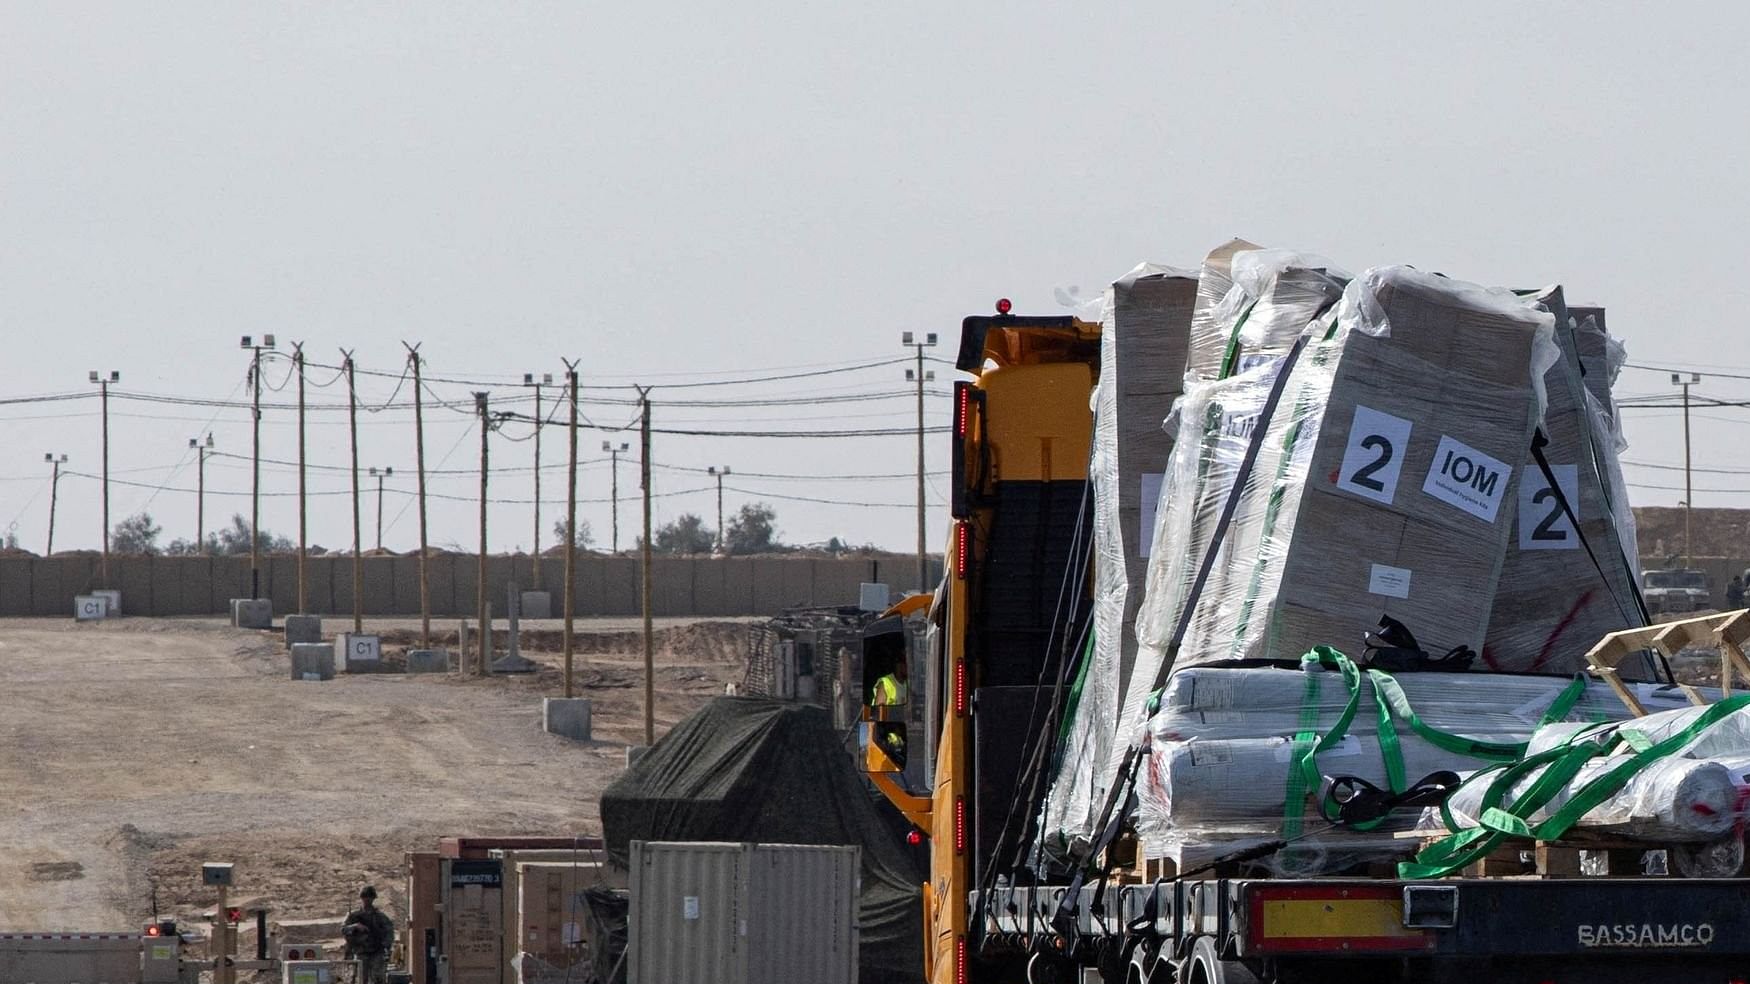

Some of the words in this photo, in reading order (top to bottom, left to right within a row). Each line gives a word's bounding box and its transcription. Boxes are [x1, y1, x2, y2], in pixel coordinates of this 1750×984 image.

[1350, 434, 1393, 493] 2
[1440, 449, 1499, 497] IOM
[1531, 487, 1567, 541] 2
[84, 602, 99, 614] C1
[355, 641, 372, 655] C1
[1577, 922, 1715, 947] BASSAMCO
